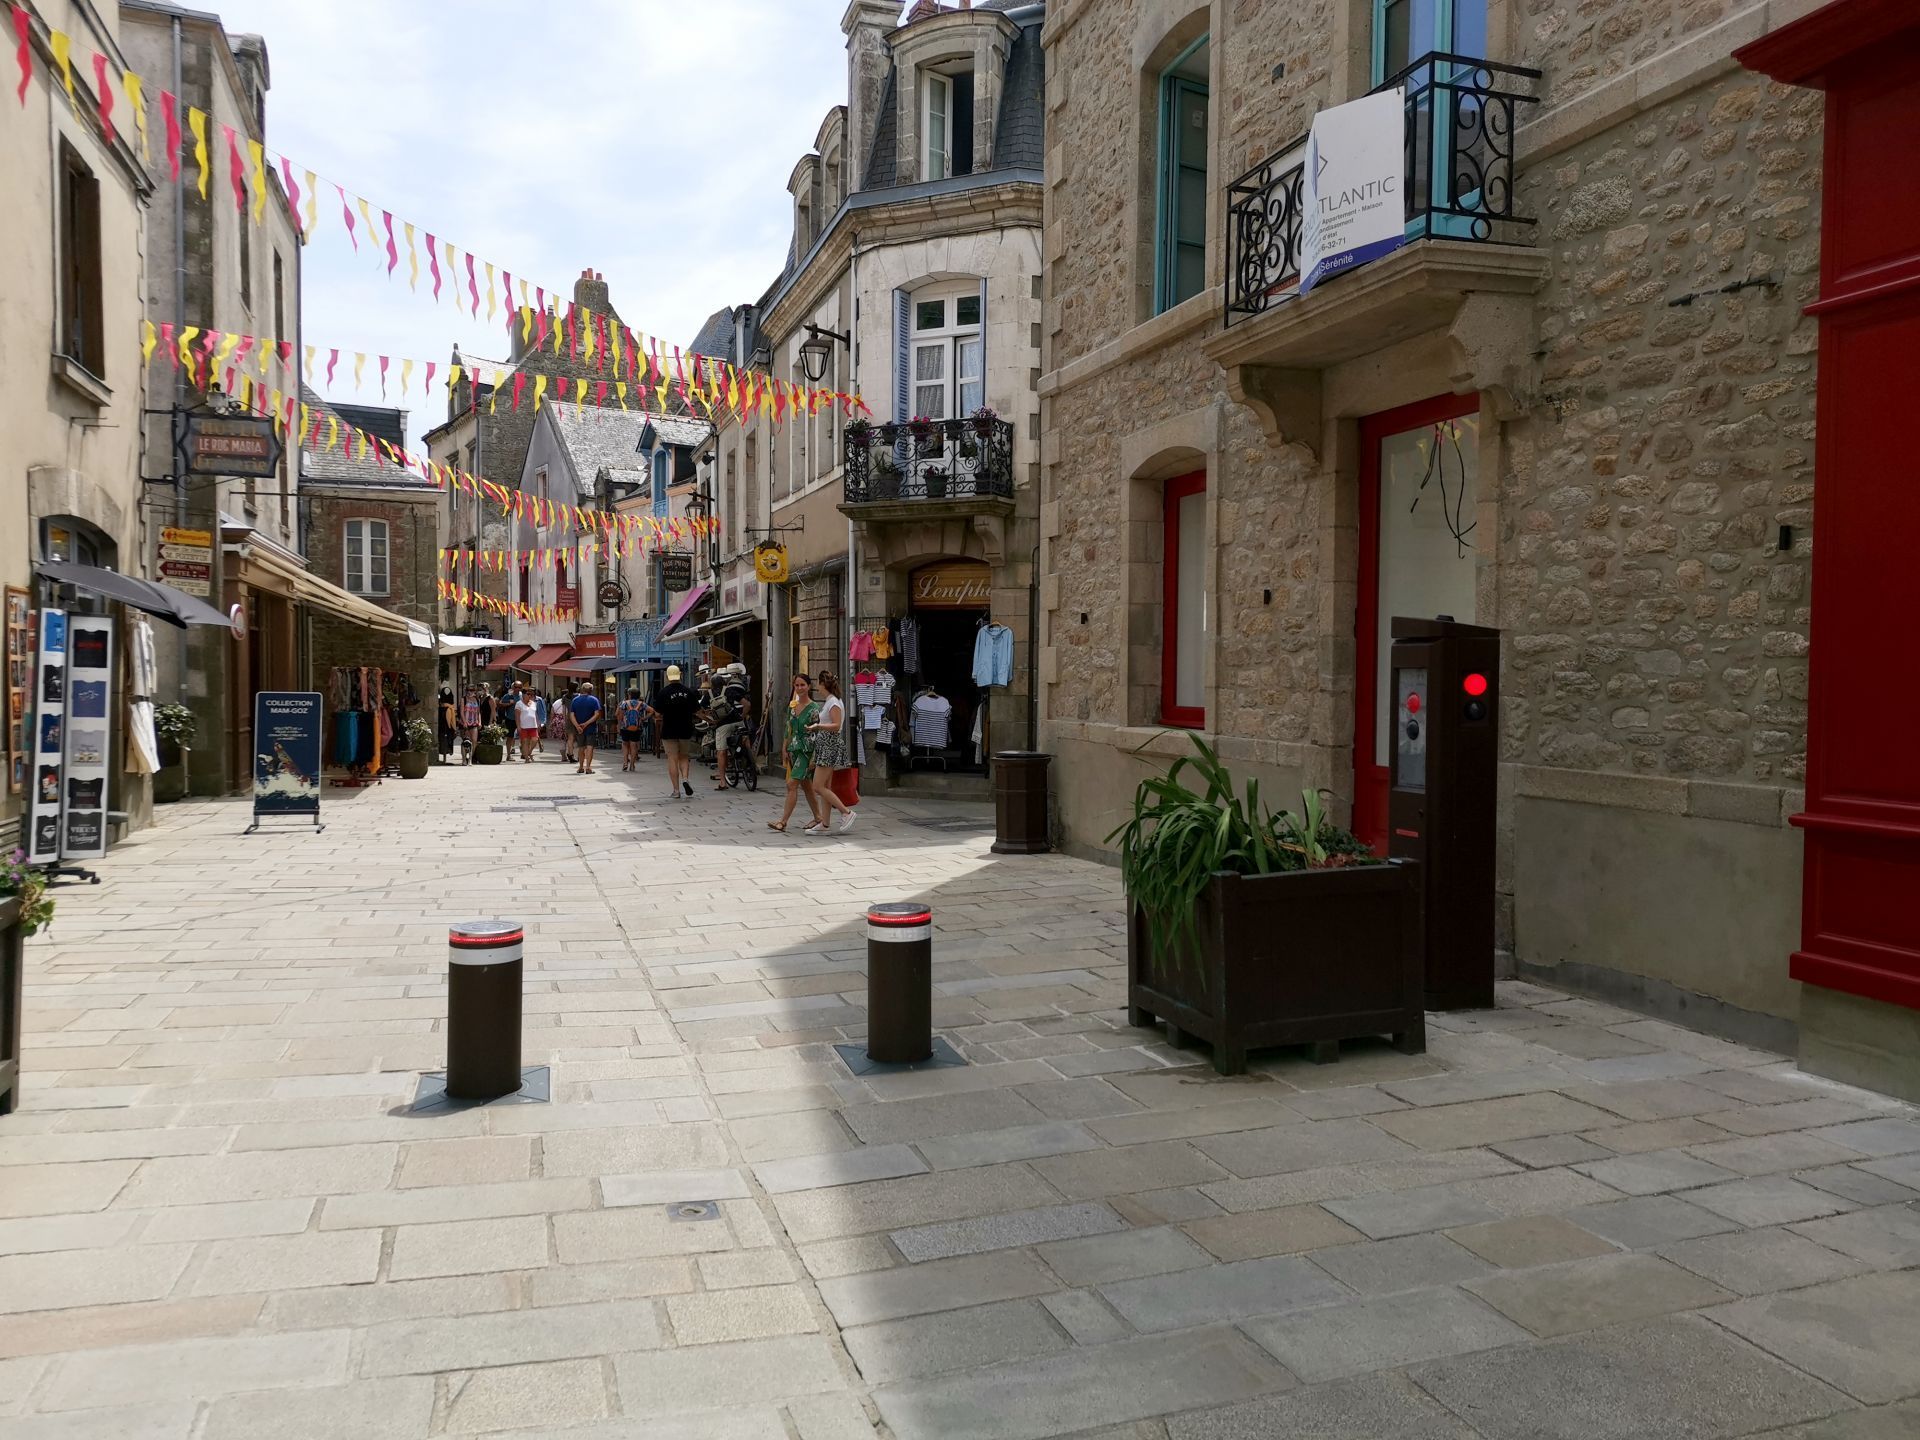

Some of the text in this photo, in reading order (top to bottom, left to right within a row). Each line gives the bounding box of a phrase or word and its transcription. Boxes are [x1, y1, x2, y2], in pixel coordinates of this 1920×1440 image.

[1321, 207, 1358, 226] Appartement
[1361, 200, 1384, 213] Maison
[1319, 252, 1355, 272] Sérénité
[199, 438, 264, 454] LE ROC MARIA
[265, 699, 314, 707] COLLECTION
